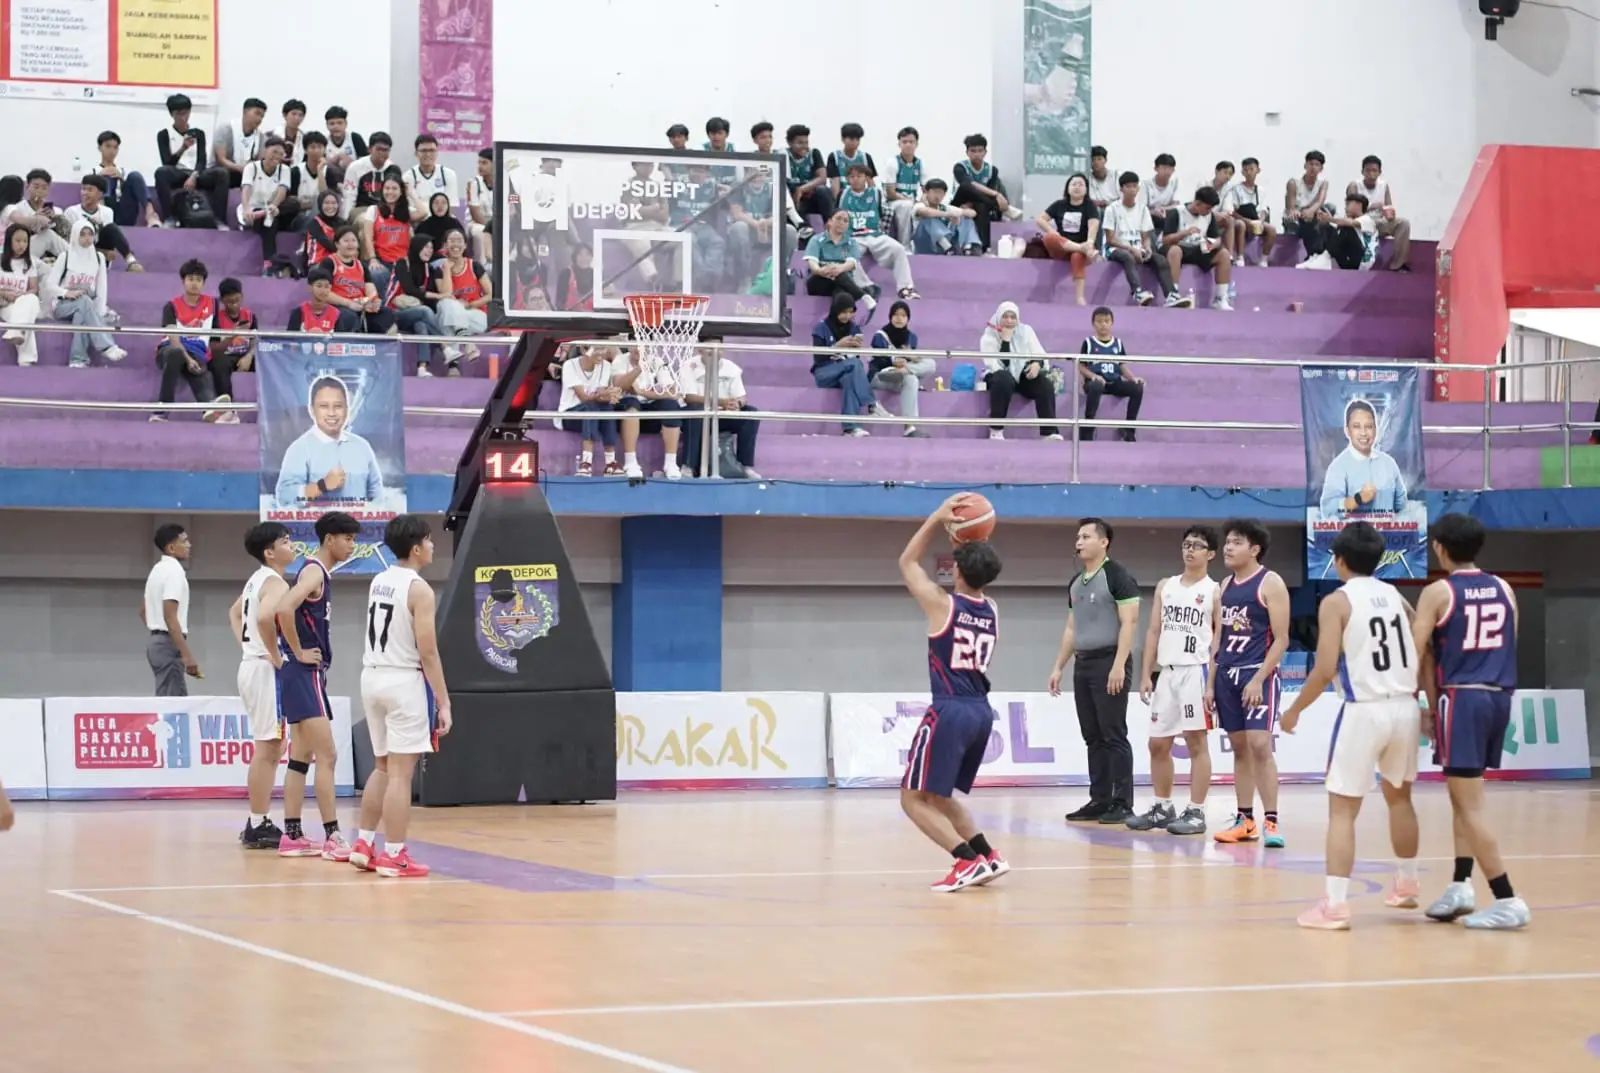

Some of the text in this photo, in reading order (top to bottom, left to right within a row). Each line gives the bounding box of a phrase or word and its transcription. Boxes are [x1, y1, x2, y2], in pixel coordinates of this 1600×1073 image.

[572, 202, 643, 221] DEPOK
[1101, 363, 1114, 374] 30
[485, 452, 533, 479] 14
[267, 511, 293, 520] LIGA
[1312, 522, 1336, 530] LIGA
[514, 567, 552, 578] DEPOK
[369, 601, 394, 653] 17
[1461, 603, 1507, 651] 12
[950, 626, 996, 673] 20
[1184, 635, 1197, 653] 18
[1225, 634, 1251, 653] 77
[1369, 613, 1408, 672] 31
[1184, 703, 1195, 719] 18
[80, 717, 117, 730] LIGA
[80, 731, 142, 744] BASKET
[80, 746, 149, 758] PELAJAR
